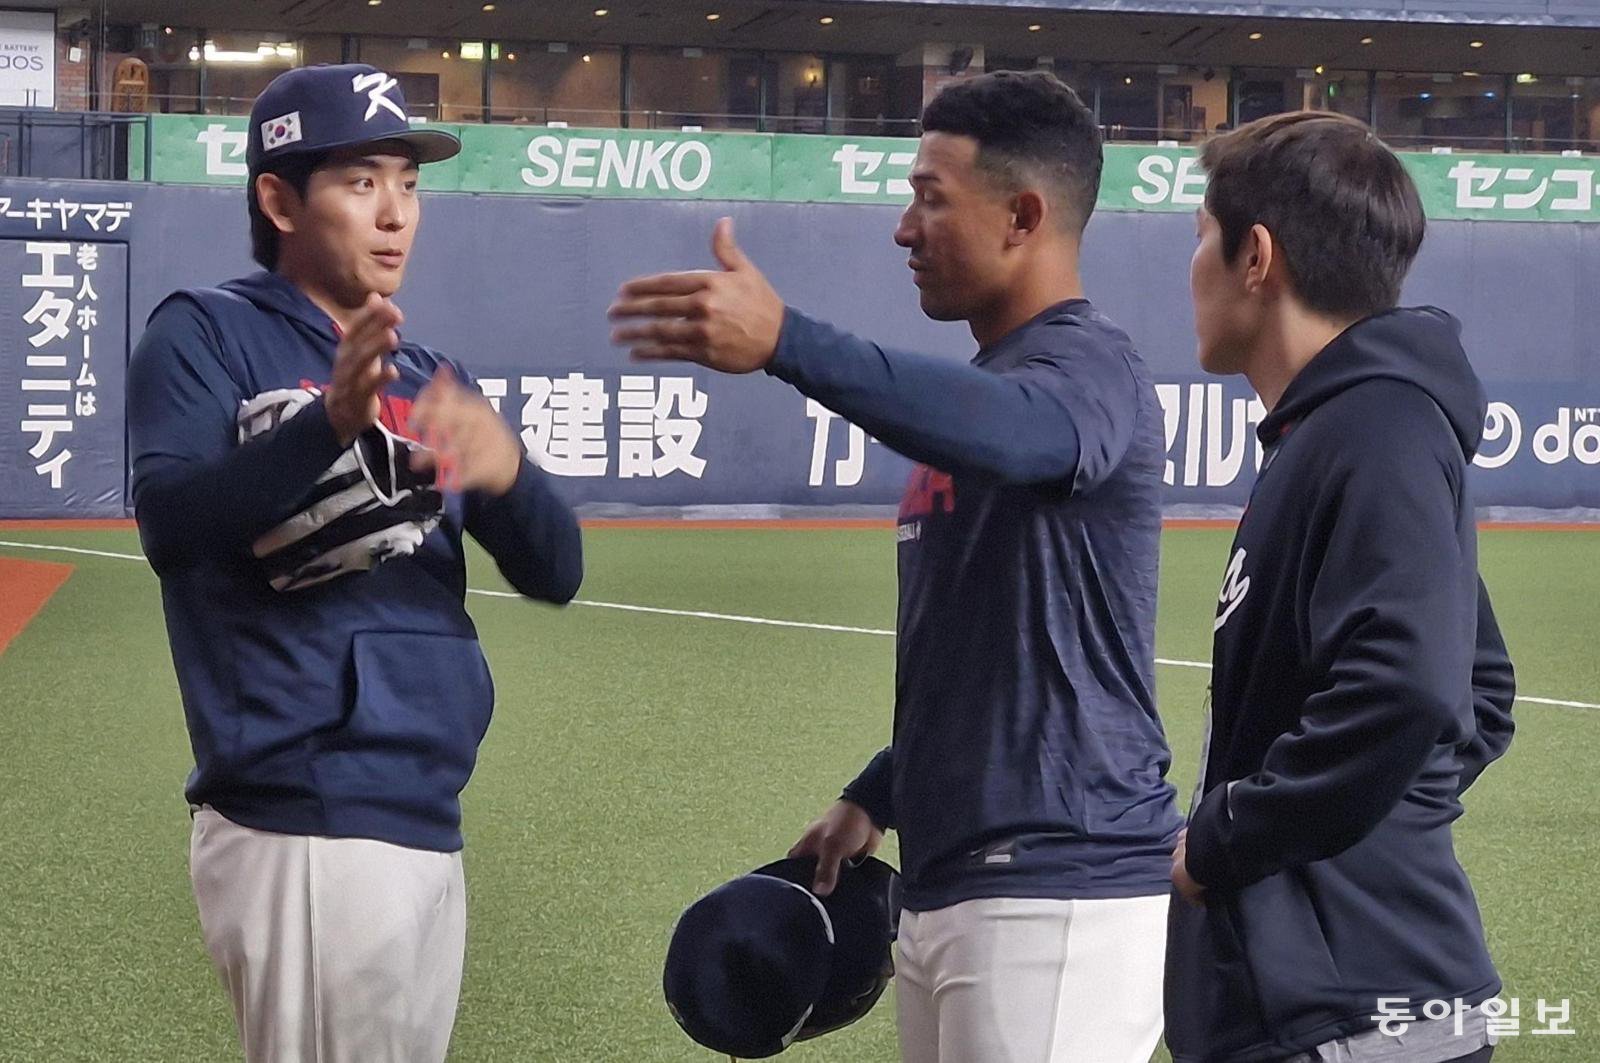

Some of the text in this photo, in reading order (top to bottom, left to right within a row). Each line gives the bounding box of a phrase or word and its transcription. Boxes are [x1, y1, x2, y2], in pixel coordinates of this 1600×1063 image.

[521, 135, 712, 192] SENKO
[1447, 160, 1600, 211] センコ
[21, 242, 75, 489] エタニティ
[75, 243, 98, 417] 老人ホームは
[476, 372, 709, 480] 建設
[1574, 407, 1600, 422] NT
